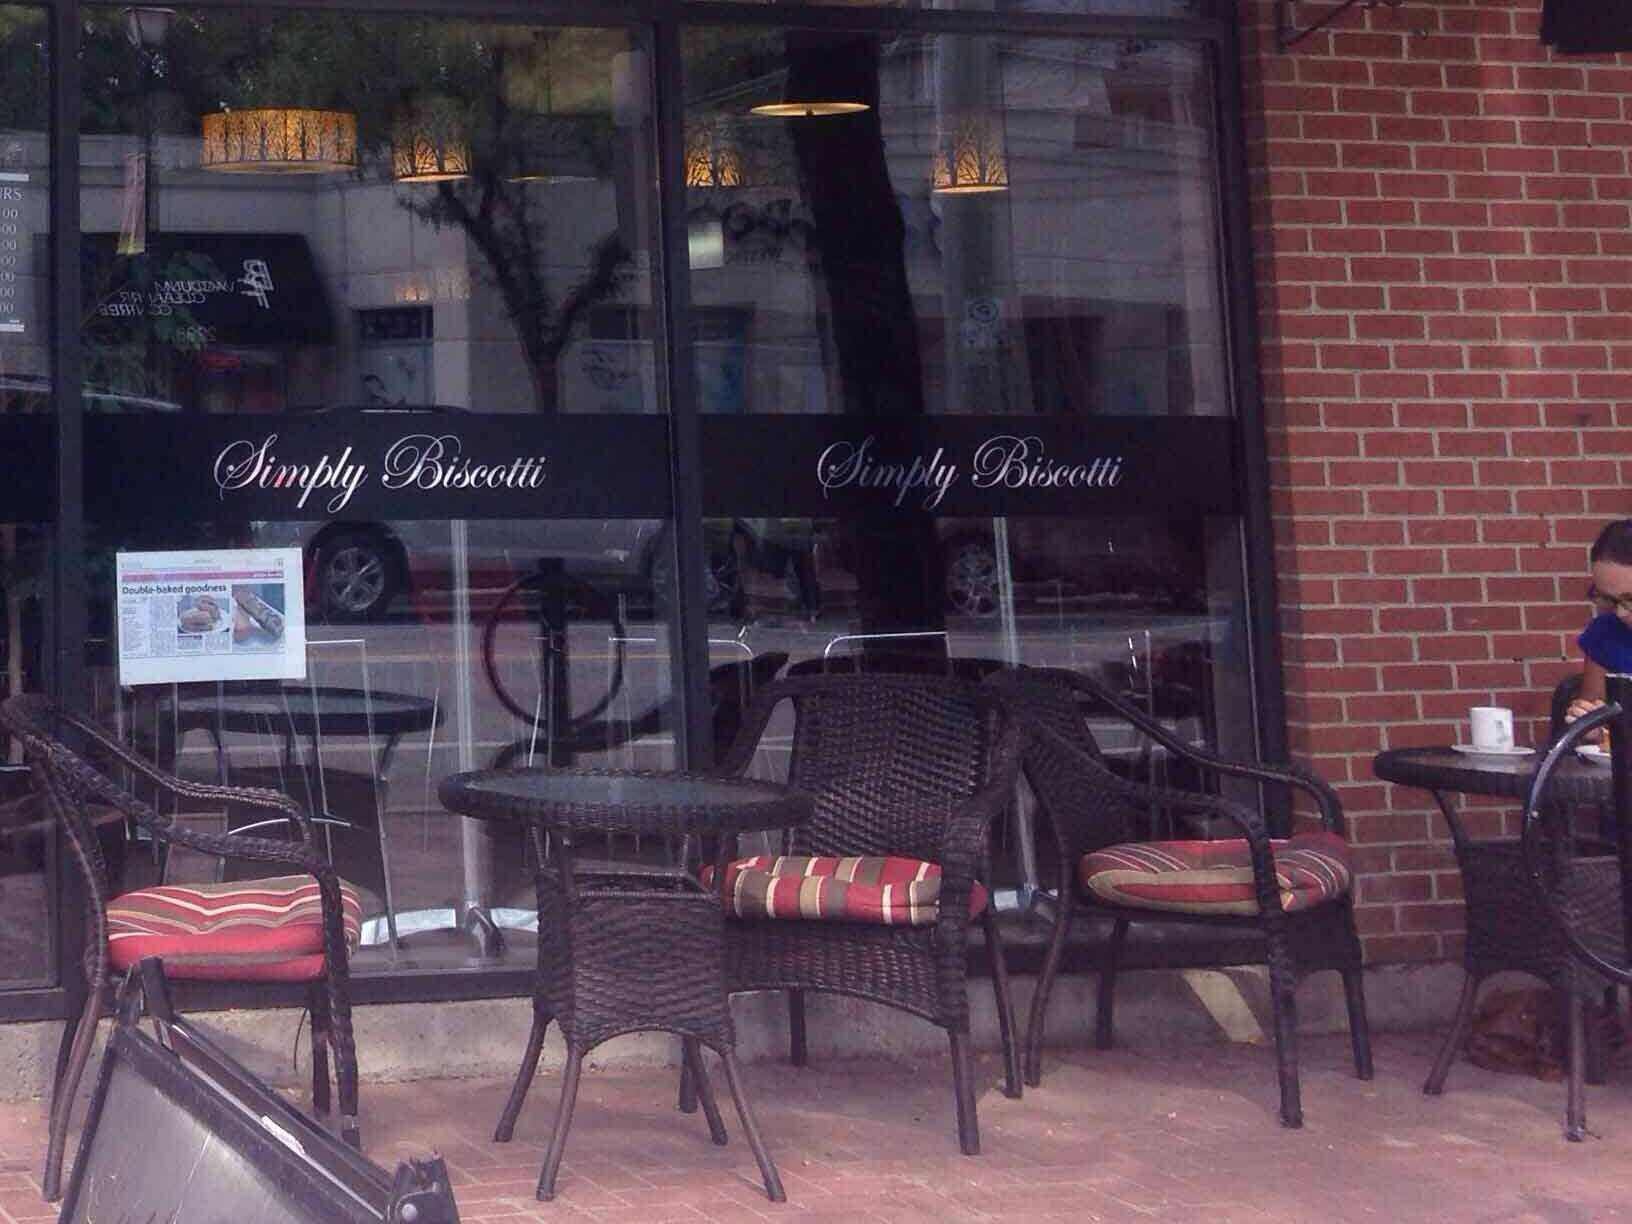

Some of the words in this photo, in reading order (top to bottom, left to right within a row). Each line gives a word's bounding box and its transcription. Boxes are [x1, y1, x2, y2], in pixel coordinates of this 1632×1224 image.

[214, 433, 368, 513] Simply
[381, 434, 546, 489] Biscotti
[817, 434, 960, 510] Simply
[971, 435, 1123, 488] Biscotti
